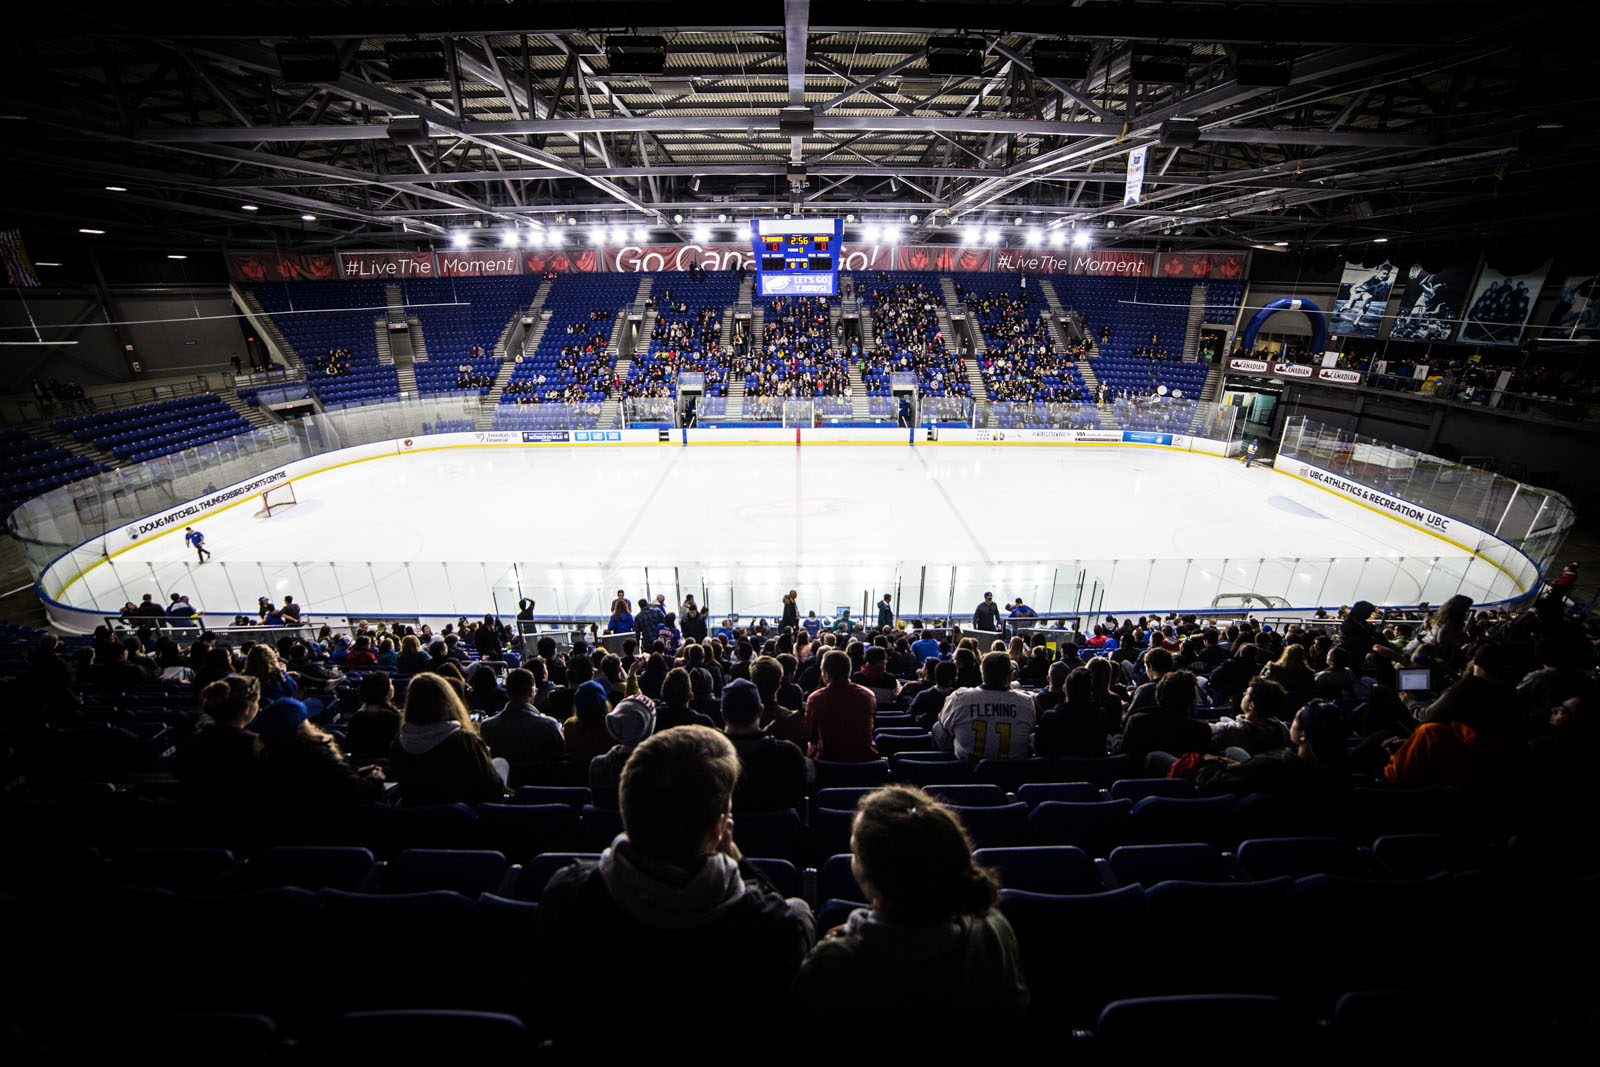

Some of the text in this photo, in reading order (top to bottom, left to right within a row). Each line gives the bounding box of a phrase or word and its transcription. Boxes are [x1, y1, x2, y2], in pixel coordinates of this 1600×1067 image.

[772, 243, 779, 251] 0
[790, 236, 809, 245] 2:56
[821, 242, 827, 251] 0
[443, 257, 514, 273] Moment
[615, 246, 665, 273] Go
[1074, 256, 1145, 273] Moment
[794, 276, 828, 284] LET'S GO
[1241, 362, 1265, 371] CANADIAN
[1284, 366, 1310, 376] CANADIAN
[1329, 372, 1358, 382] CANADIAN
[138, 518, 165, 535] DOUG
[164, 505, 200, 526] MITCHELL
[200, 486, 245, 511] THUNDERBIRD
[244, 478, 267, 493] SPORTS
[266, 470, 287, 484] CENTRE
[1310, 470, 1425, 522] UBC ATHLETICS & RECREATION
[1427, 514, 1450, 530] UBC
[969, 703, 1017, 718] FLEMING
[971, 719, 1012, 762] 11
